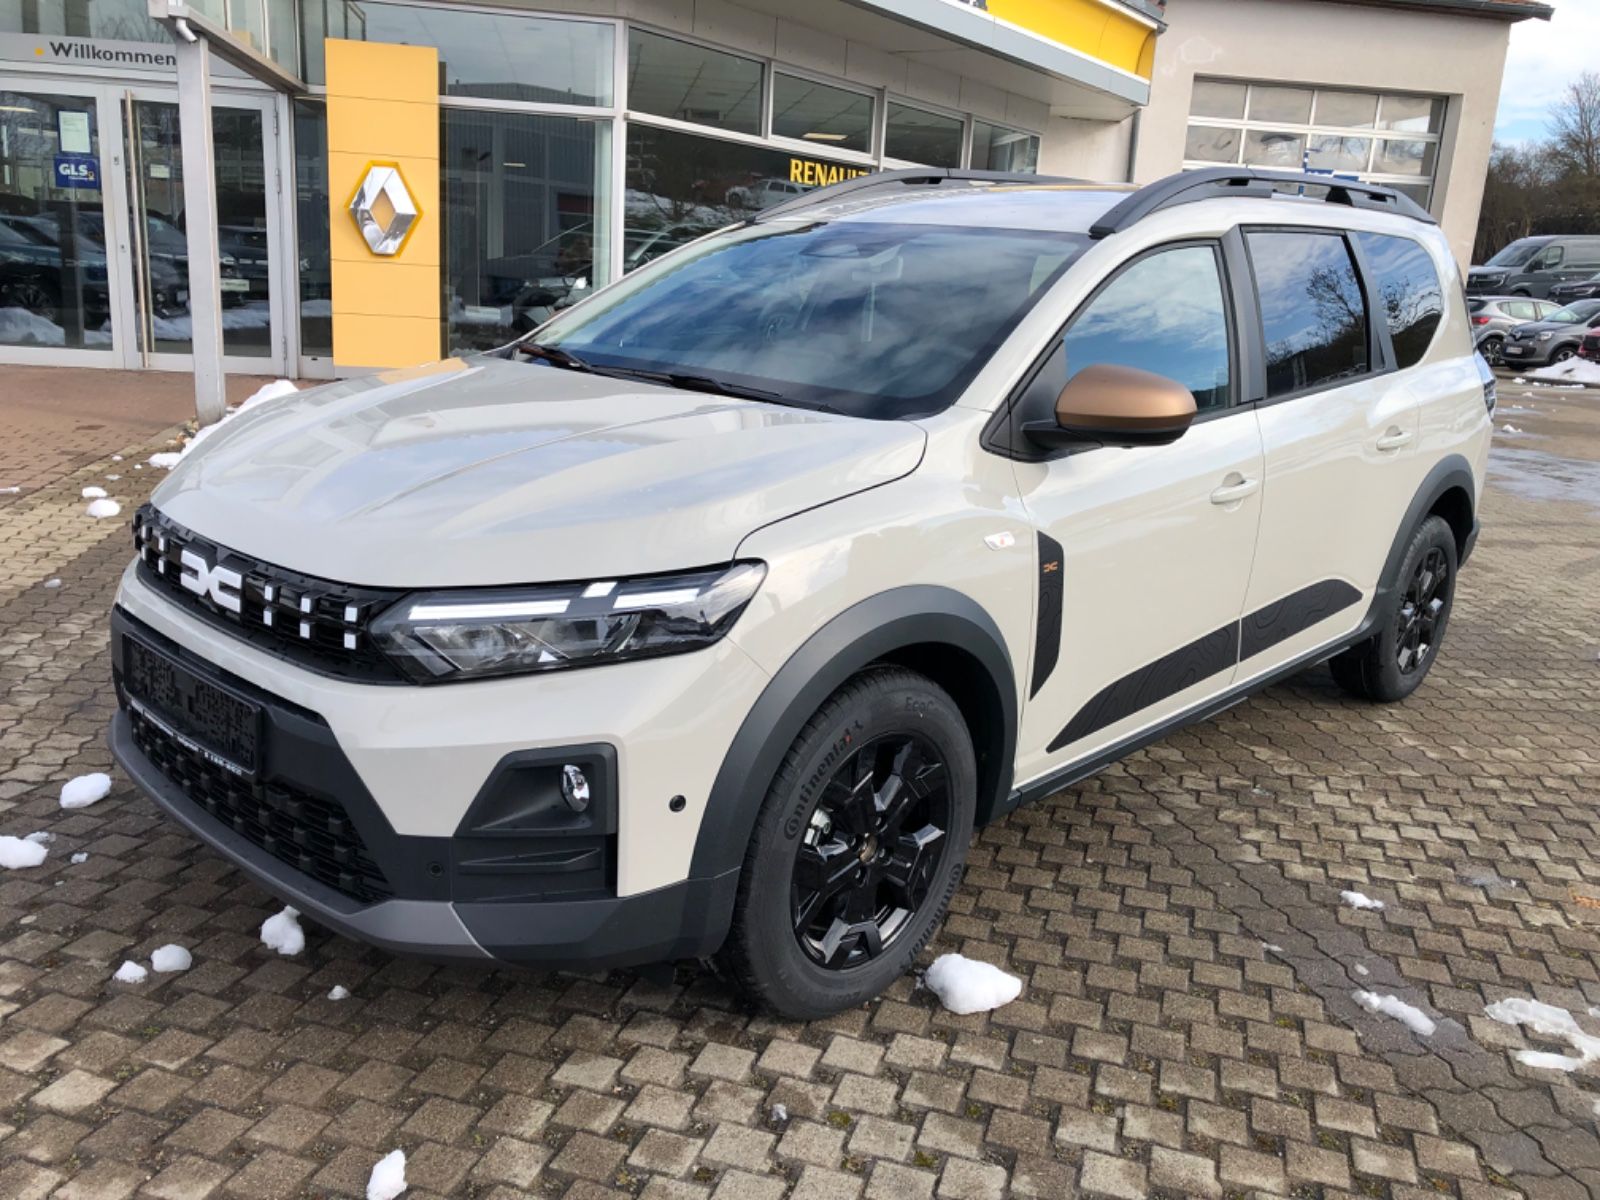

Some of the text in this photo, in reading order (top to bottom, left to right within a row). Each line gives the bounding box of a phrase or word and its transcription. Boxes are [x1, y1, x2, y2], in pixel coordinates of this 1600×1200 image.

[49, 41, 176, 66] Willkommen
[58, 163, 88, 177] GLS
[790, 158, 870, 187] RENAU
